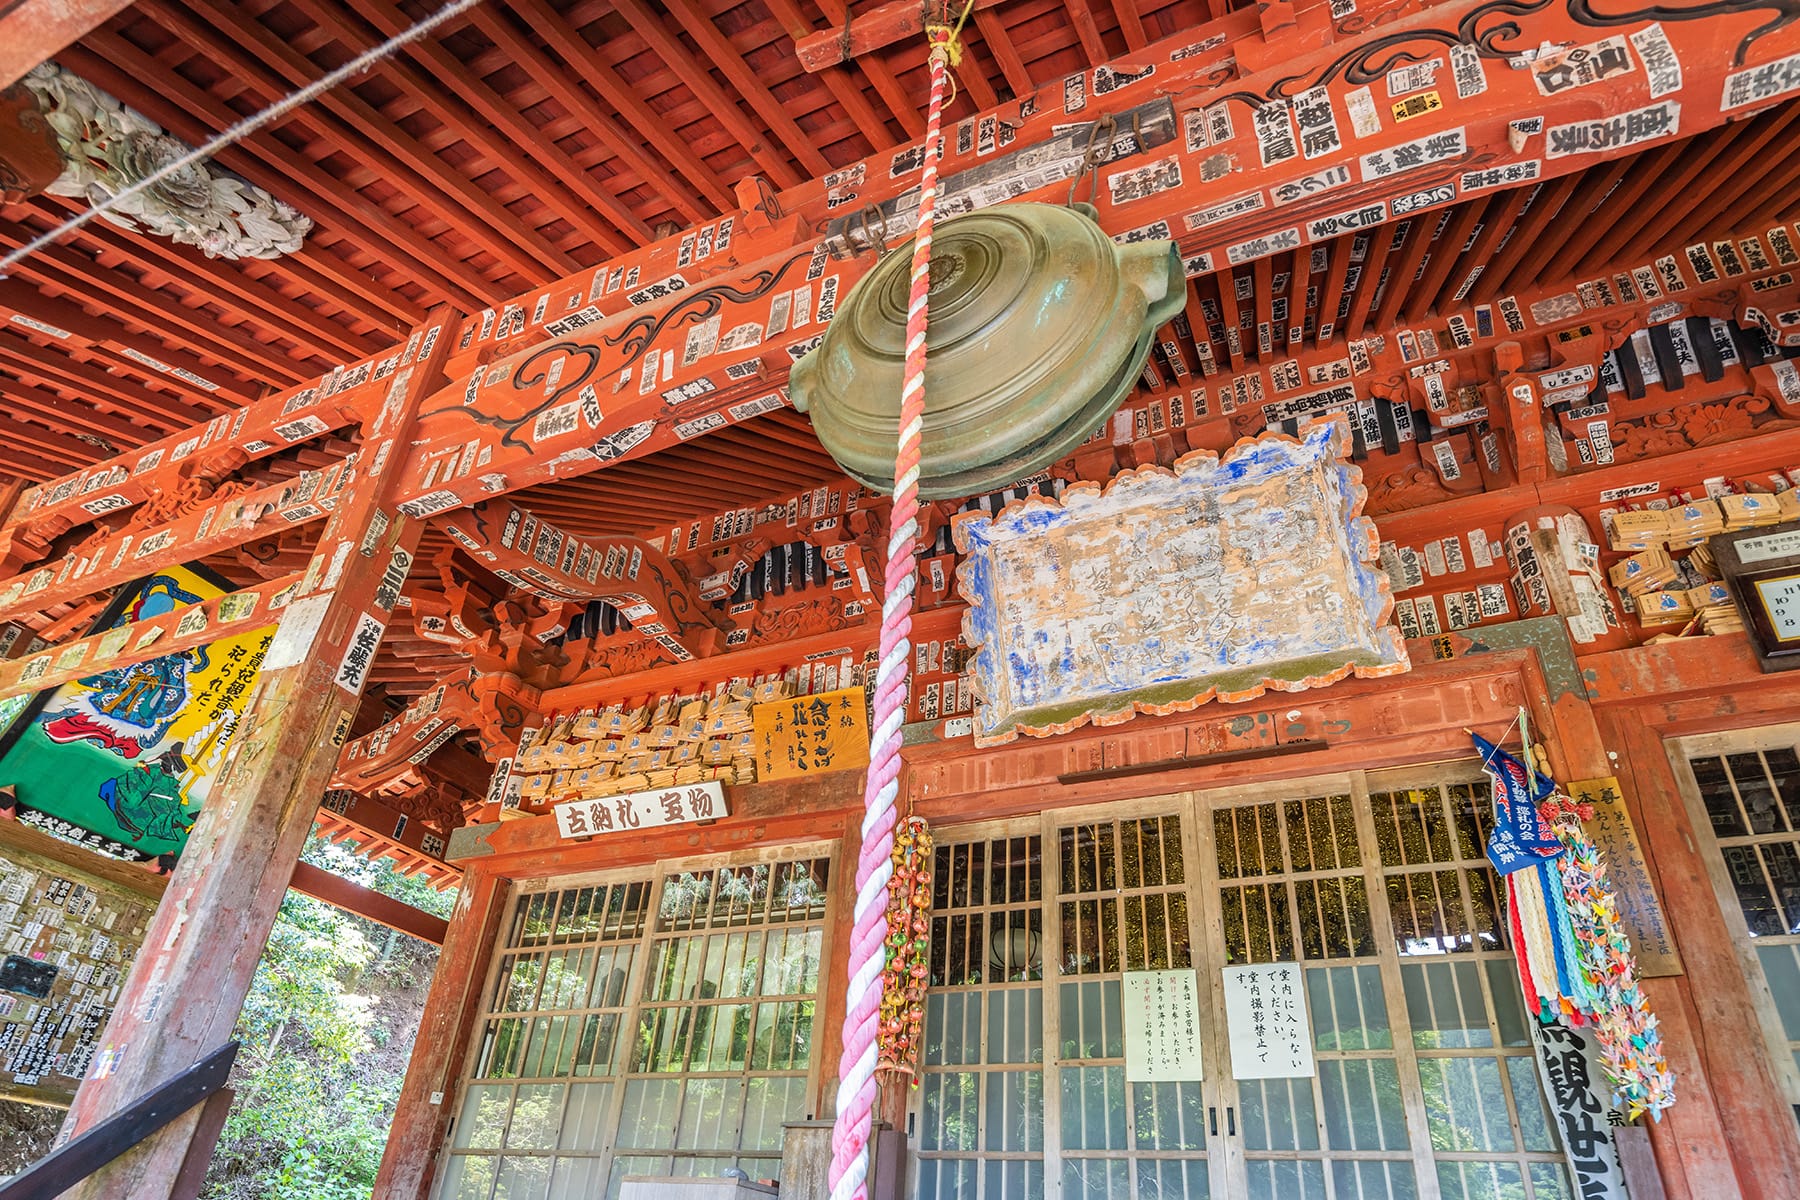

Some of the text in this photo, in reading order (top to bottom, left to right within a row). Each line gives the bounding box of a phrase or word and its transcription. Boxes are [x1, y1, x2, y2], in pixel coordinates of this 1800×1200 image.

[1775, 597, 1789, 606] 10
[1775, 609, 1786, 617] 9
[1785, 618, 1796, 627] 8
[339, 628, 378, 690] 佐藤充
[566, 788, 714, 835] 古納札・宝物
[1279, 968, 1303, 1069] 堂内に入らない
